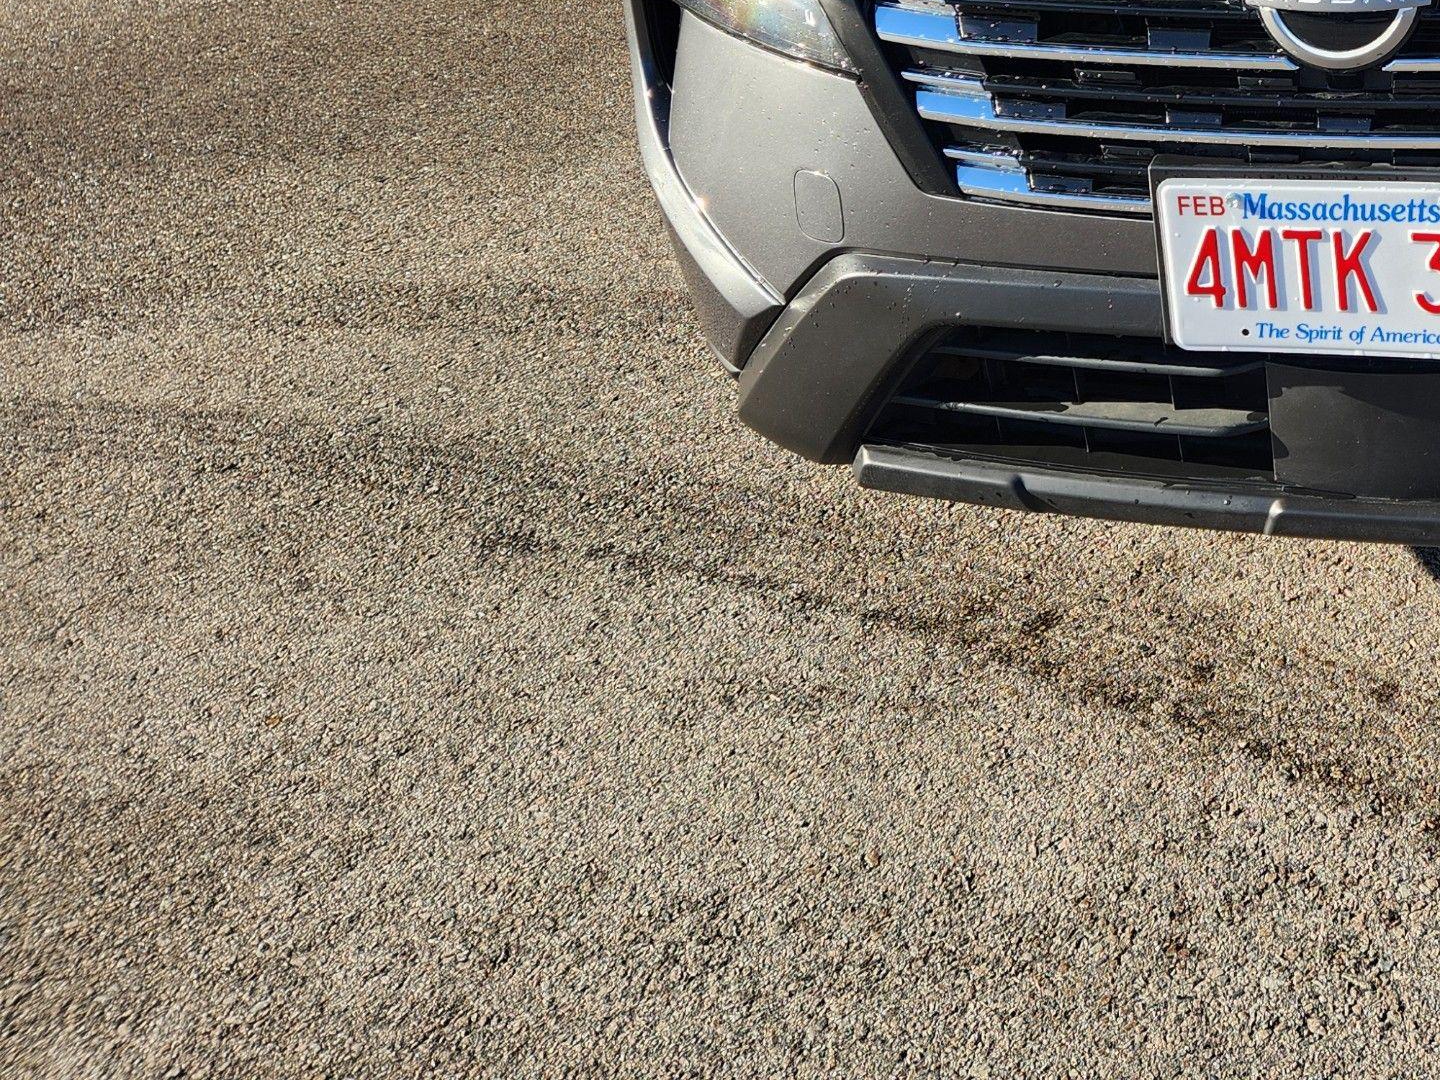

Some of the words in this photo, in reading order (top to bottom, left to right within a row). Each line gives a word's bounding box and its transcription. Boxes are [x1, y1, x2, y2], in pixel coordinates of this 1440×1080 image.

[1177, 196, 1226, 216] FEB
[1187, 228, 1378, 312] 4MTK
[1256, 322, 1290, 340] The
[1296, 323, 1342, 344] Spirit
[1350, 325, 1367, 345] of
